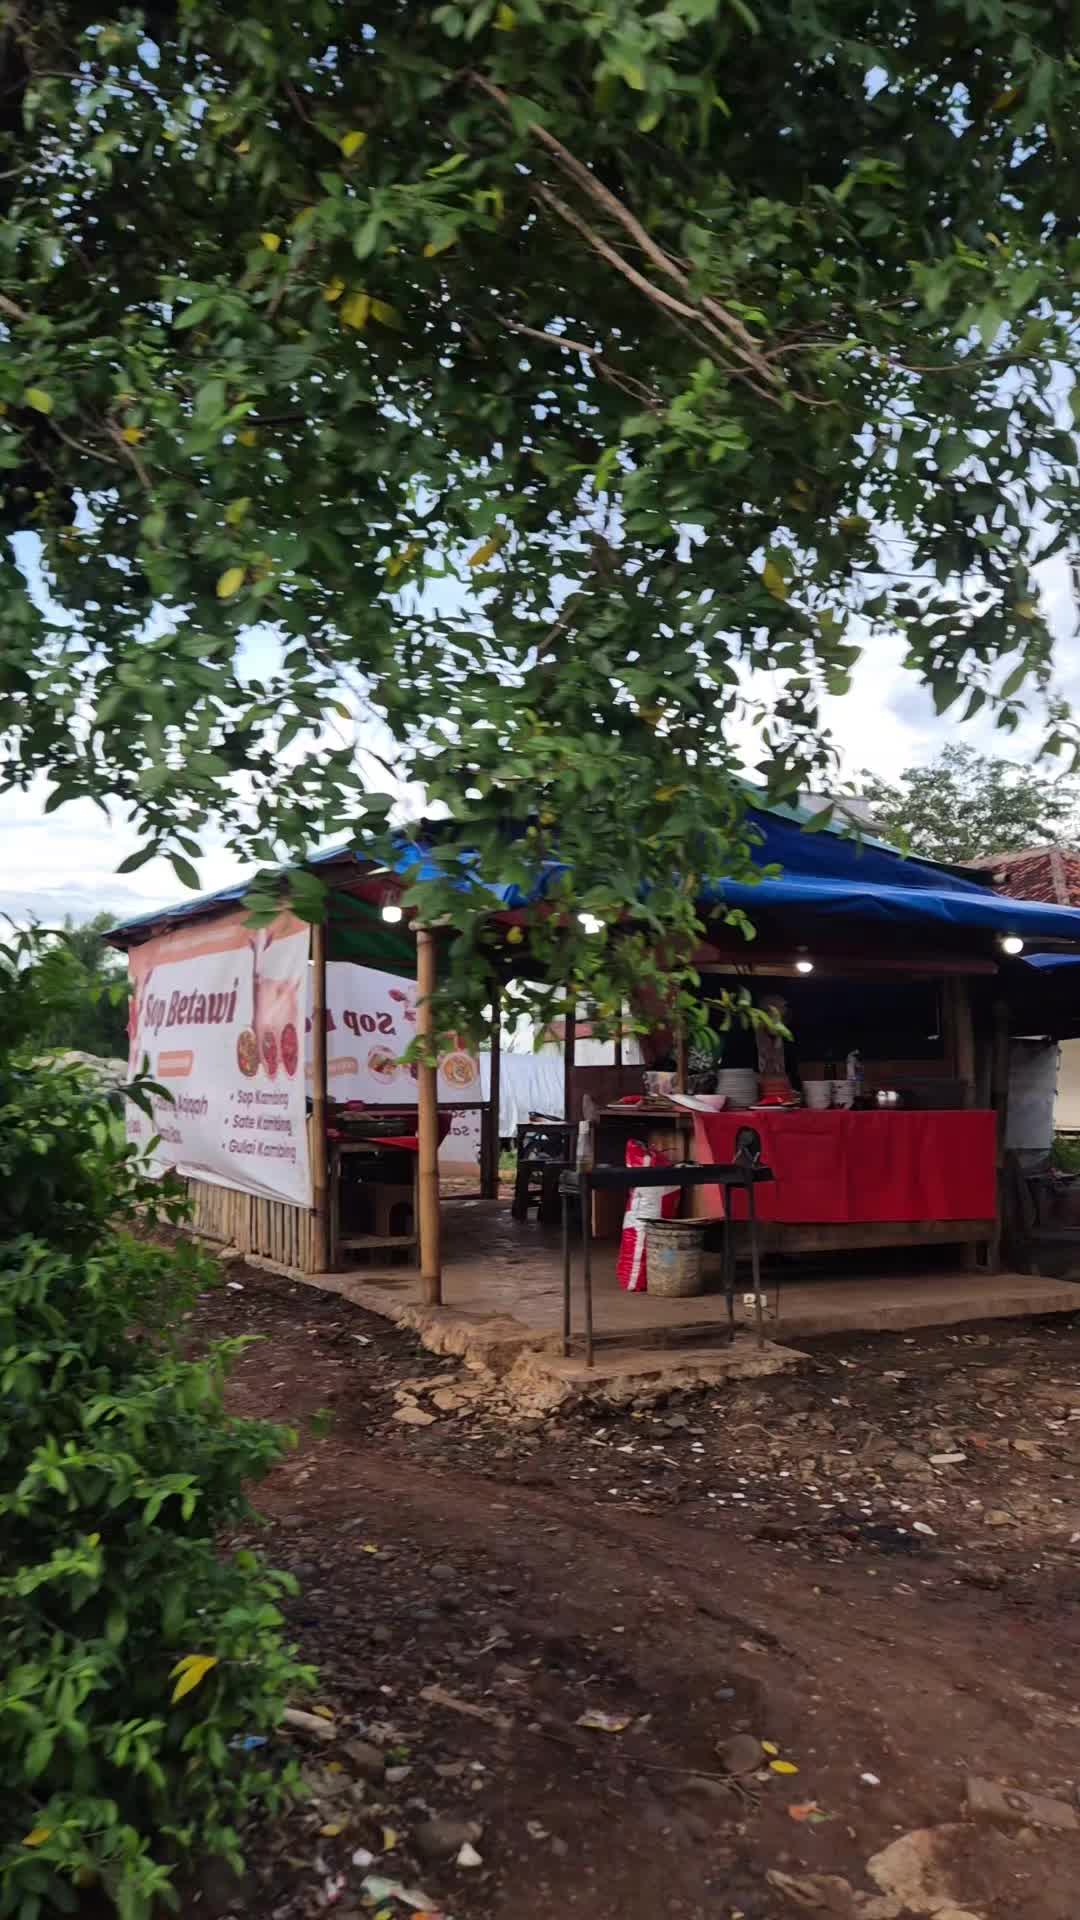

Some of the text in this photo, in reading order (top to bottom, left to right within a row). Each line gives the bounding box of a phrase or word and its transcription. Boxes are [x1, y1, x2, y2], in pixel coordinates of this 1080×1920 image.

[144, 977, 239, 1036] Sop Betawi
[237, 1090, 254, 1108] Sop
[232, 1114, 255, 1129] Sate
[229, 1139, 257, 1155] Gulai
